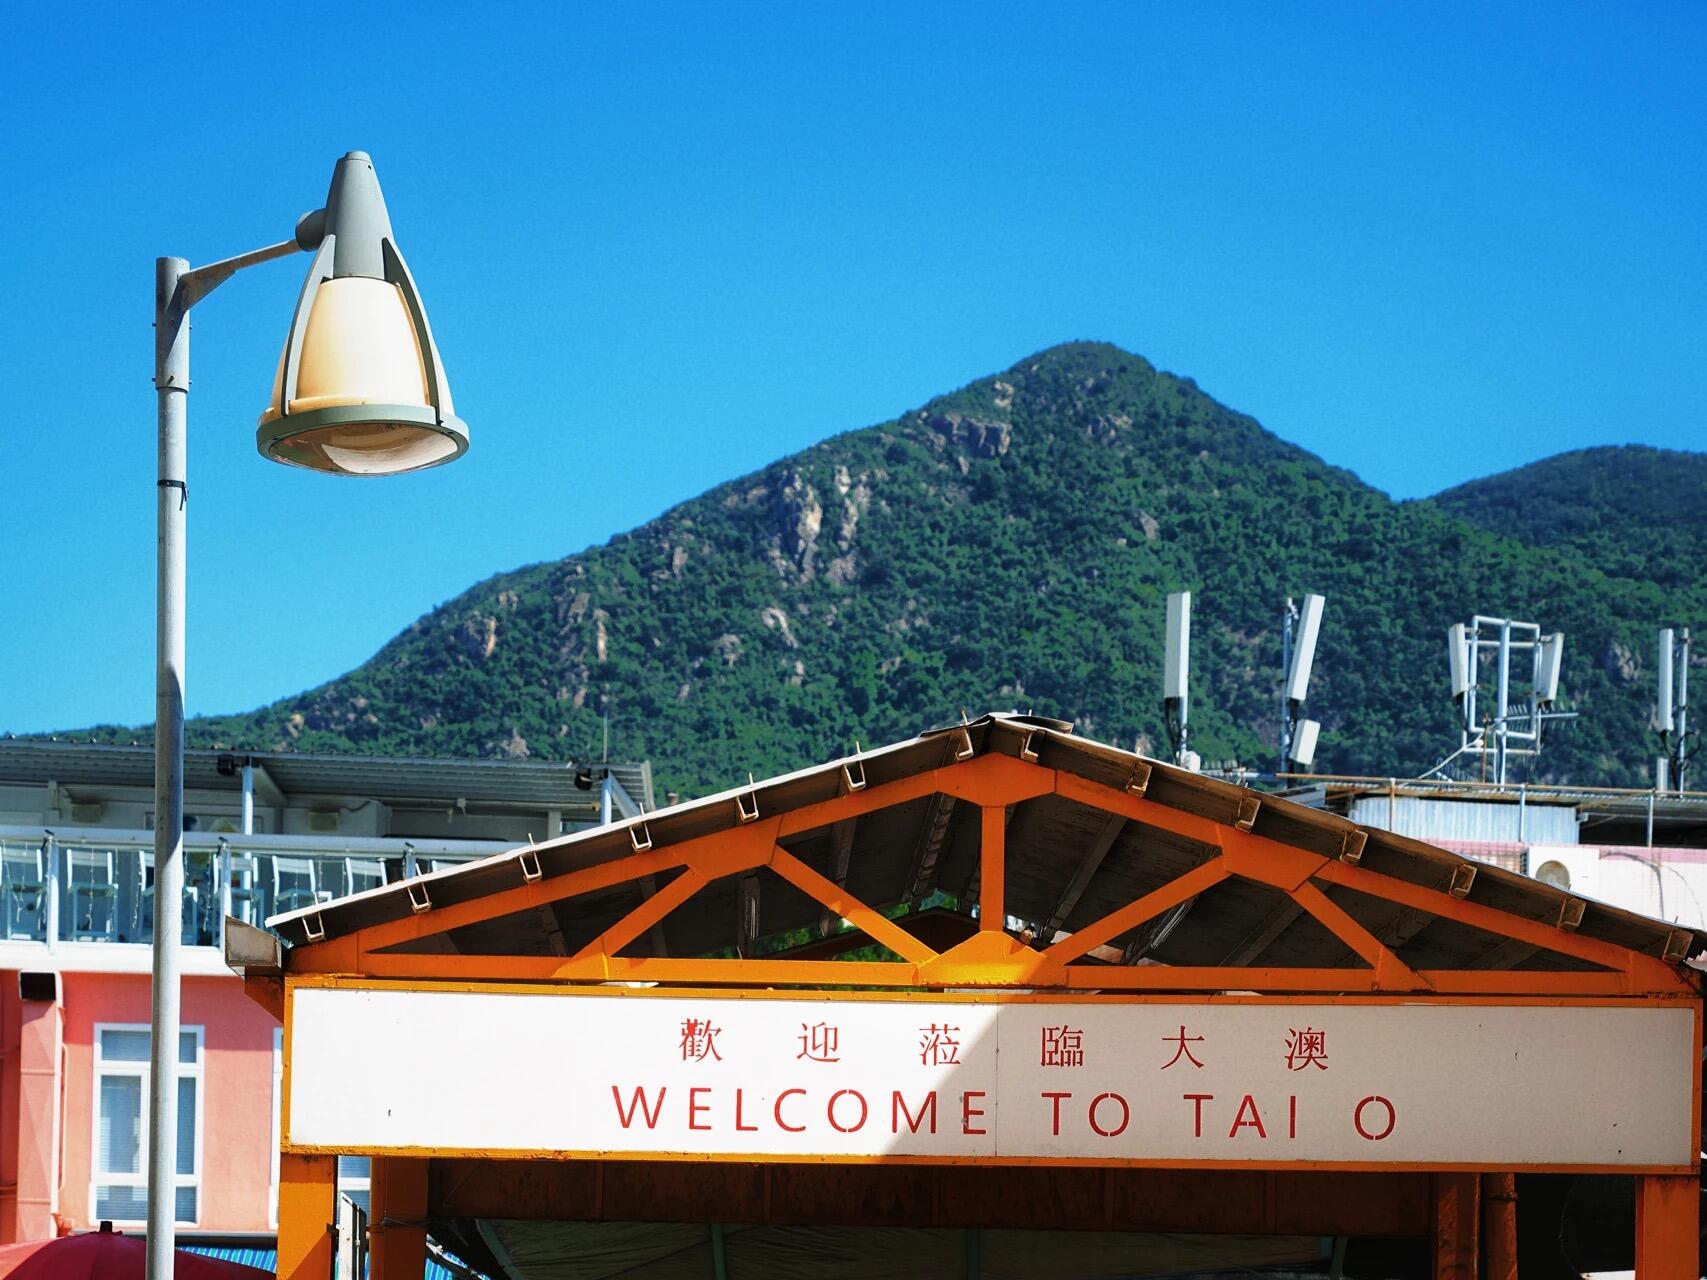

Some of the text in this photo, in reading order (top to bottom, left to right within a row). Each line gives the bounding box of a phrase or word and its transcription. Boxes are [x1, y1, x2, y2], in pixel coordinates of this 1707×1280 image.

[611, 1085, 1396, 1141] WELCOME TO TAI O
